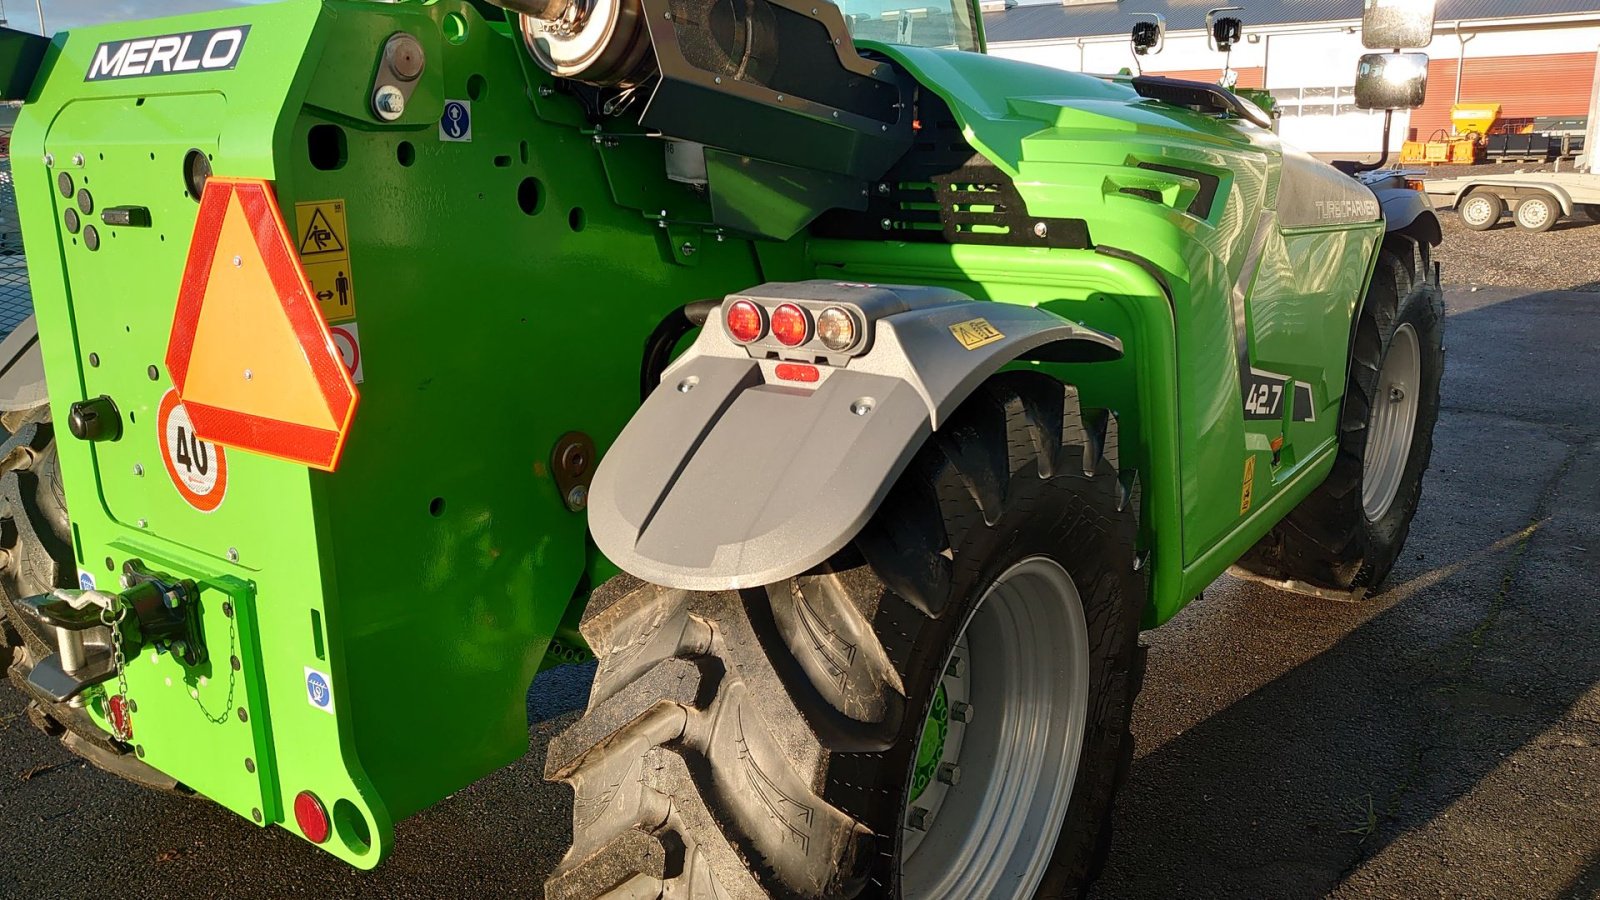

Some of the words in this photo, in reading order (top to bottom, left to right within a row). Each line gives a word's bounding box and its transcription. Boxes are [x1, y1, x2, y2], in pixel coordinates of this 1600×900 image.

[88, 29, 243, 79] MERLO
[1245, 383, 1283, 414] 42.7
[176, 426, 208, 475] 40
